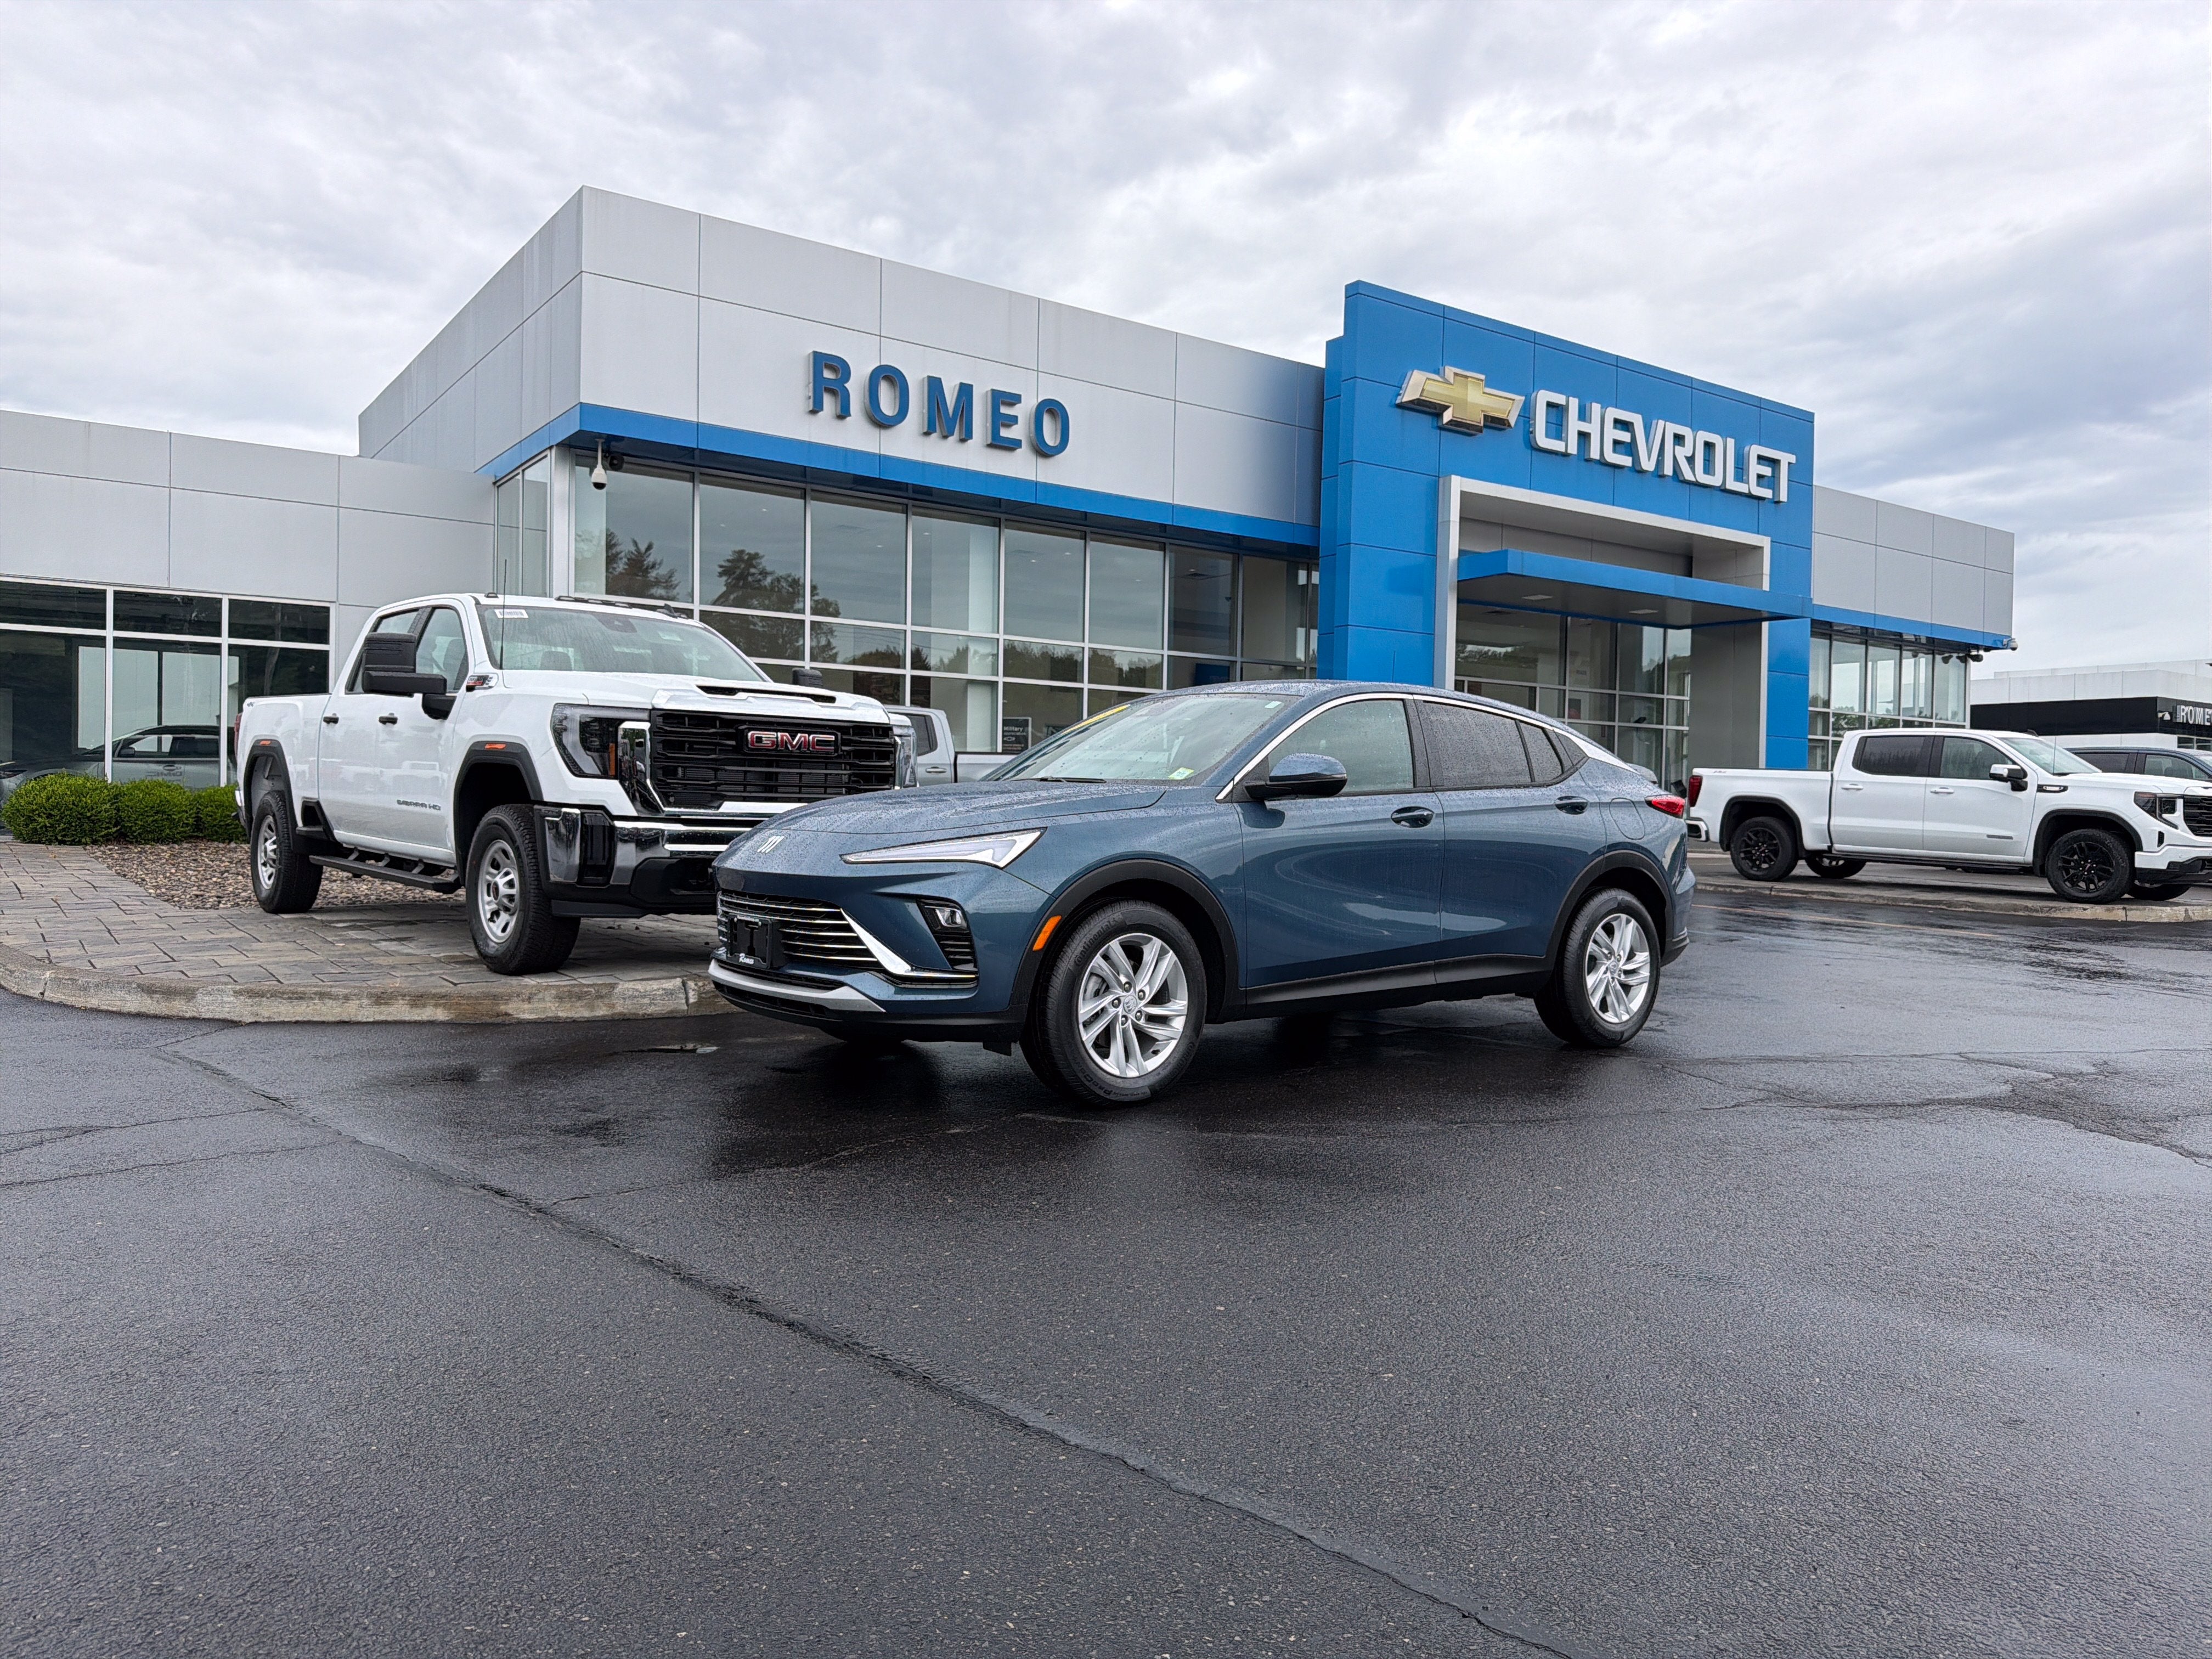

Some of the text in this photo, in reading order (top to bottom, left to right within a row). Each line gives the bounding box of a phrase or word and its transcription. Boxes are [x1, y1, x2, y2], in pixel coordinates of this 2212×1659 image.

[809, 351, 1070, 456] ROMEO
[1531, 390, 1796, 503] CHEVROLET
[2177, 705, 2212, 726] ROME
[748, 731, 835, 753] GMC
[1074, 919, 1114, 967] Continental
